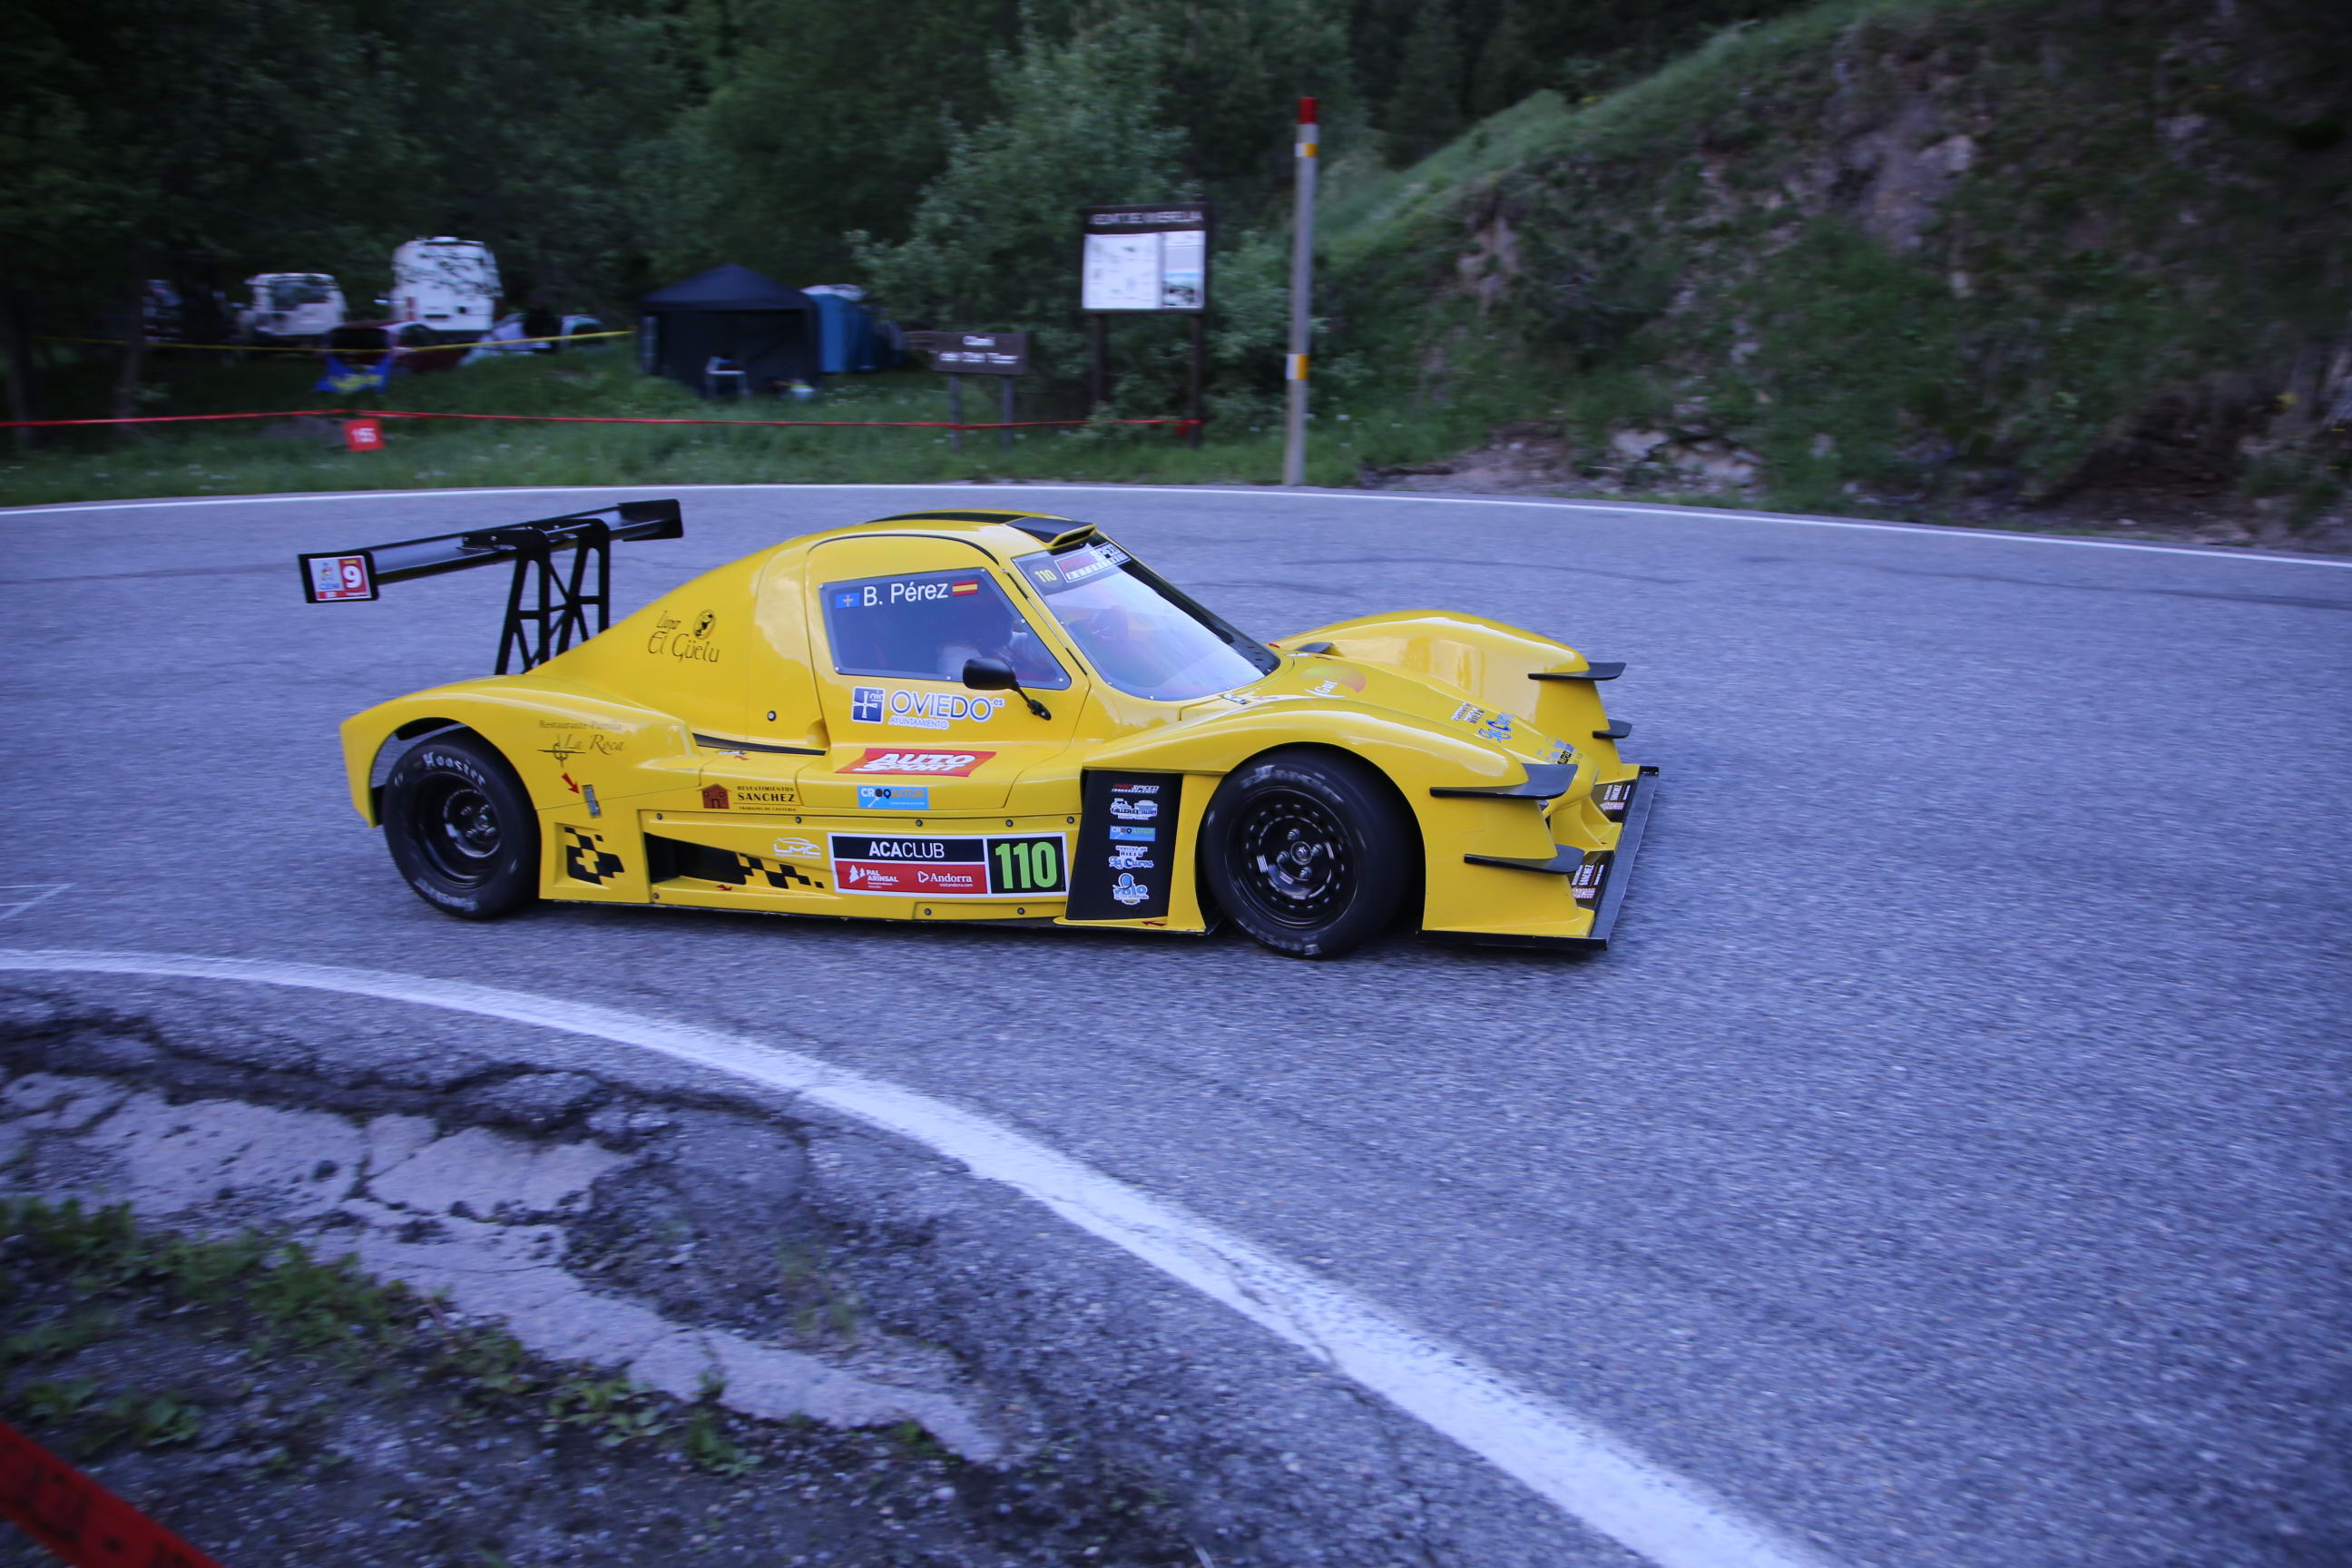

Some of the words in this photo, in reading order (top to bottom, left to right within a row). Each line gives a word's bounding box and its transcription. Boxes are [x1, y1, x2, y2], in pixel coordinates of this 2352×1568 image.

[343, 565, 363, 588] 9
[1034, 570, 1058, 583] 110
[863, 585, 884, 607] B.
[890, 582, 948, 603] Pérez
[647, 631, 668, 654] El
[868, 753, 976, 764] AUTO
[738, 792, 796, 803] SANCHEZ
[868, 840, 945, 858] ACACLUB
[995, 841, 1056, 889] 110
[931, 872, 973, 883] Andorra
